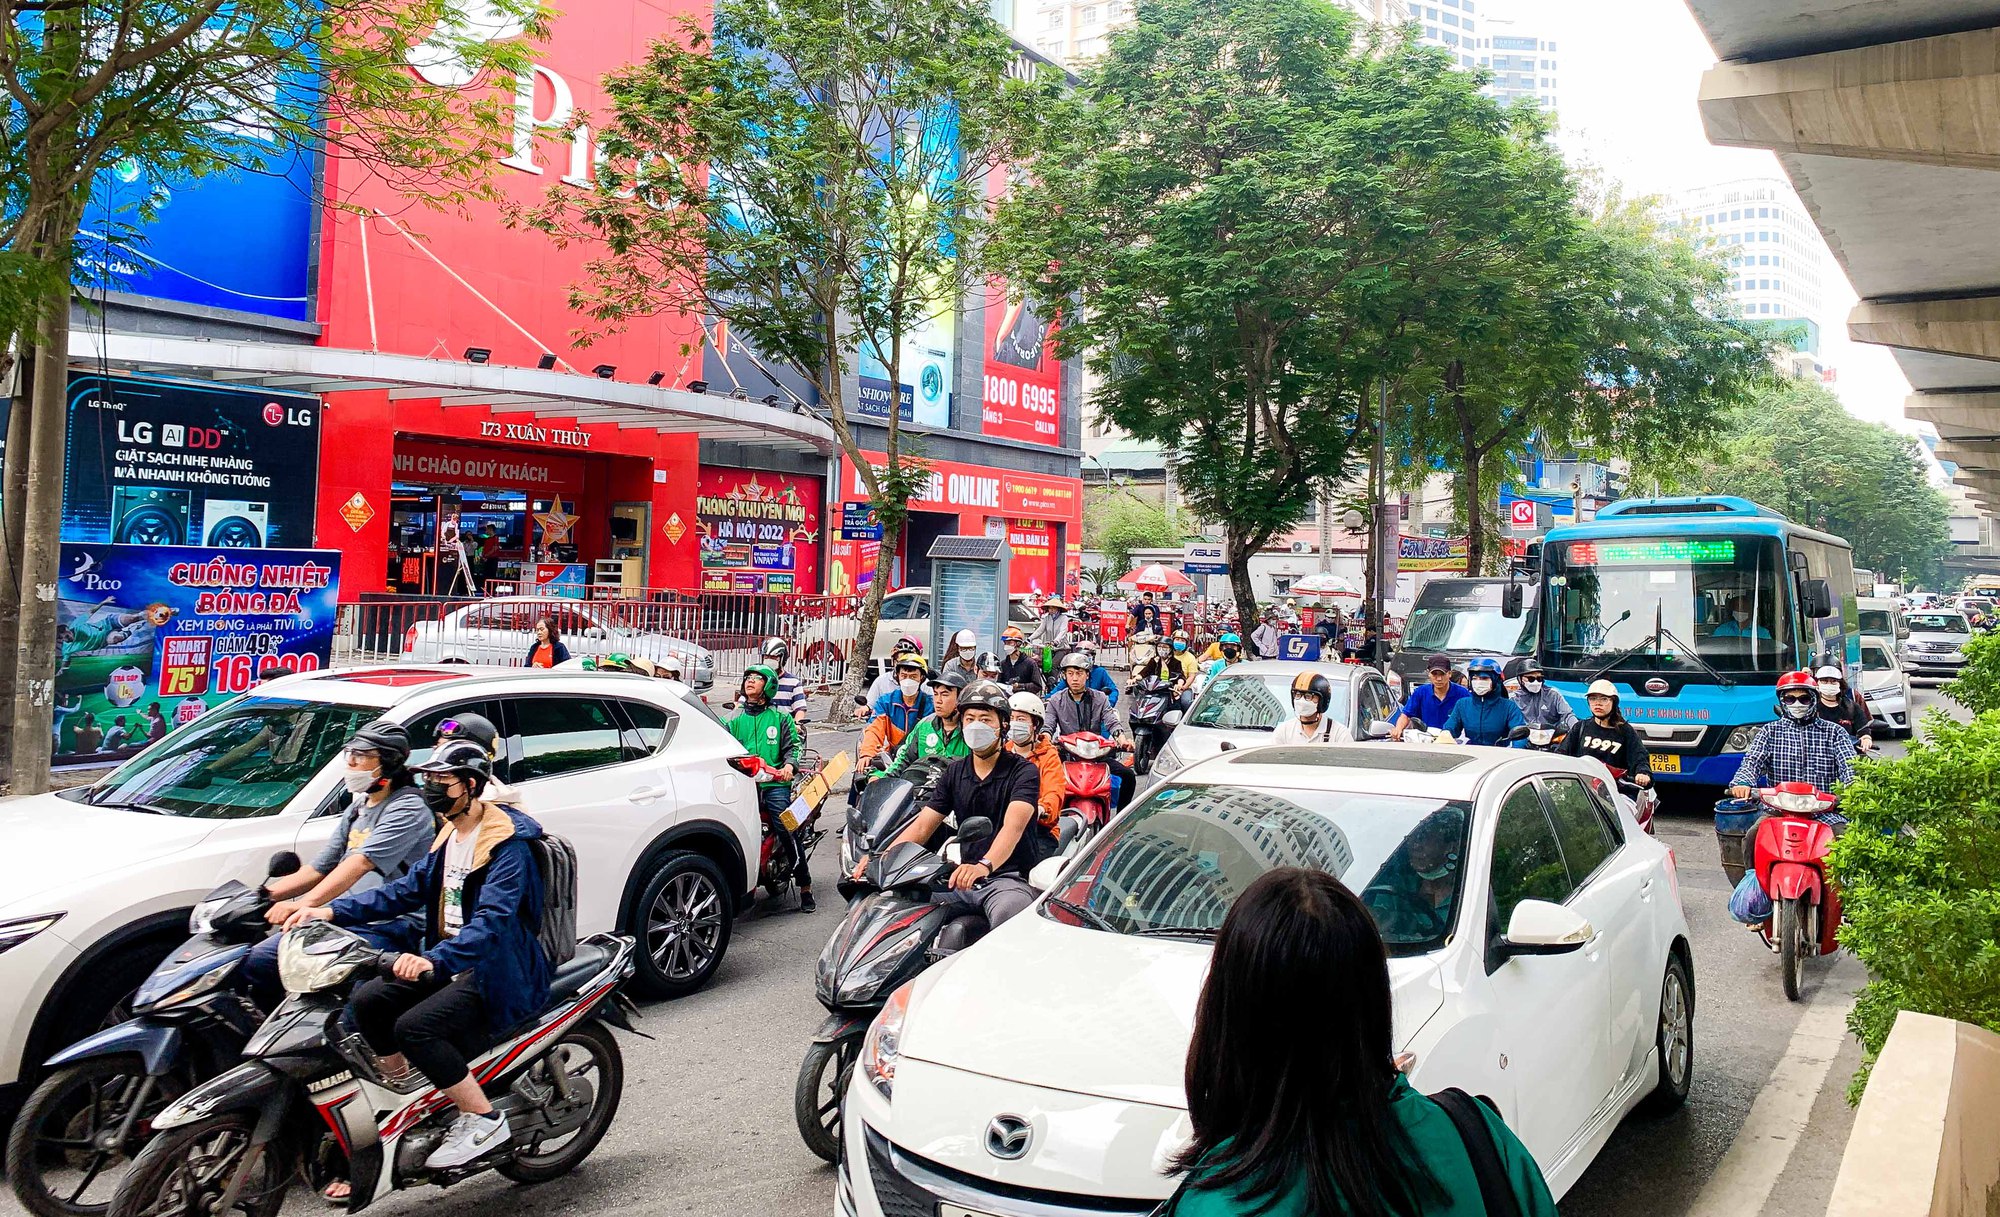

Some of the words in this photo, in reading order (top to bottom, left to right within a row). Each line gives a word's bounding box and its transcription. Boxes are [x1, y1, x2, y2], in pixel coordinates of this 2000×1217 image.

[88, 400, 100, 408] LG
[983, 375, 1017, 407] 1800
[1022, 383, 1056, 415] 6995
[287, 408, 311, 427] LG
[998, 412, 1003, 425] 3
[118, 420, 153, 444] LG
[164, 428, 182, 444] AI
[480, 421, 501, 436] 173
[505, 422, 547, 442] XUÂN
[551, 427, 591, 447] THỦY
[115, 449, 145, 464] GIẶT
[147, 451, 182, 466] SẠCH
[183, 454, 208, 467] NHẸ
[210, 455, 253, 470] NHÀNG
[418, 455, 461, 475] CHÀO
[465, 459, 497, 478] QUÝ
[500, 462, 548, 482] KHÁCH
[138, 468, 184, 482] NHANH
[186, 469, 229, 484] KHÔNG
[948, 473, 999, 508] ONLINE
[697, 495, 735, 517] THÁNG
[718, 518, 733, 538] HÀ
[736, 520, 756, 542] NỘI
[758, 524, 784, 541] 2022
[1190, 548, 1221, 557] ASUS
[85, 573, 122, 590] Pico
[169, 556, 256, 588] CUỒNG
[260, 561, 331, 594] NHIỆT
[196, 588, 266, 615] BÓNG
[268, 589, 302, 615] ĐÁ
[176, 620, 203, 631] XEM
[207, 617, 245, 631] BÓNG
[298, 618, 314, 630] TO
[168, 640, 208, 653] SMART
[216, 632, 247, 654] GIẢM
[1288, 637, 1308, 658] G7
[168, 654, 189, 666] TIVI
[191, 653, 206, 666] 4K
[1635, 708, 1643, 717] CP
[1646, 708, 1655, 718] XE
[1583, 736, 1622, 754] 1997
[1652, 755, 1669, 763] 29B
[1652, 763, 1677, 772] 14.68
[306, 1069, 353, 1093] YAMAHA
